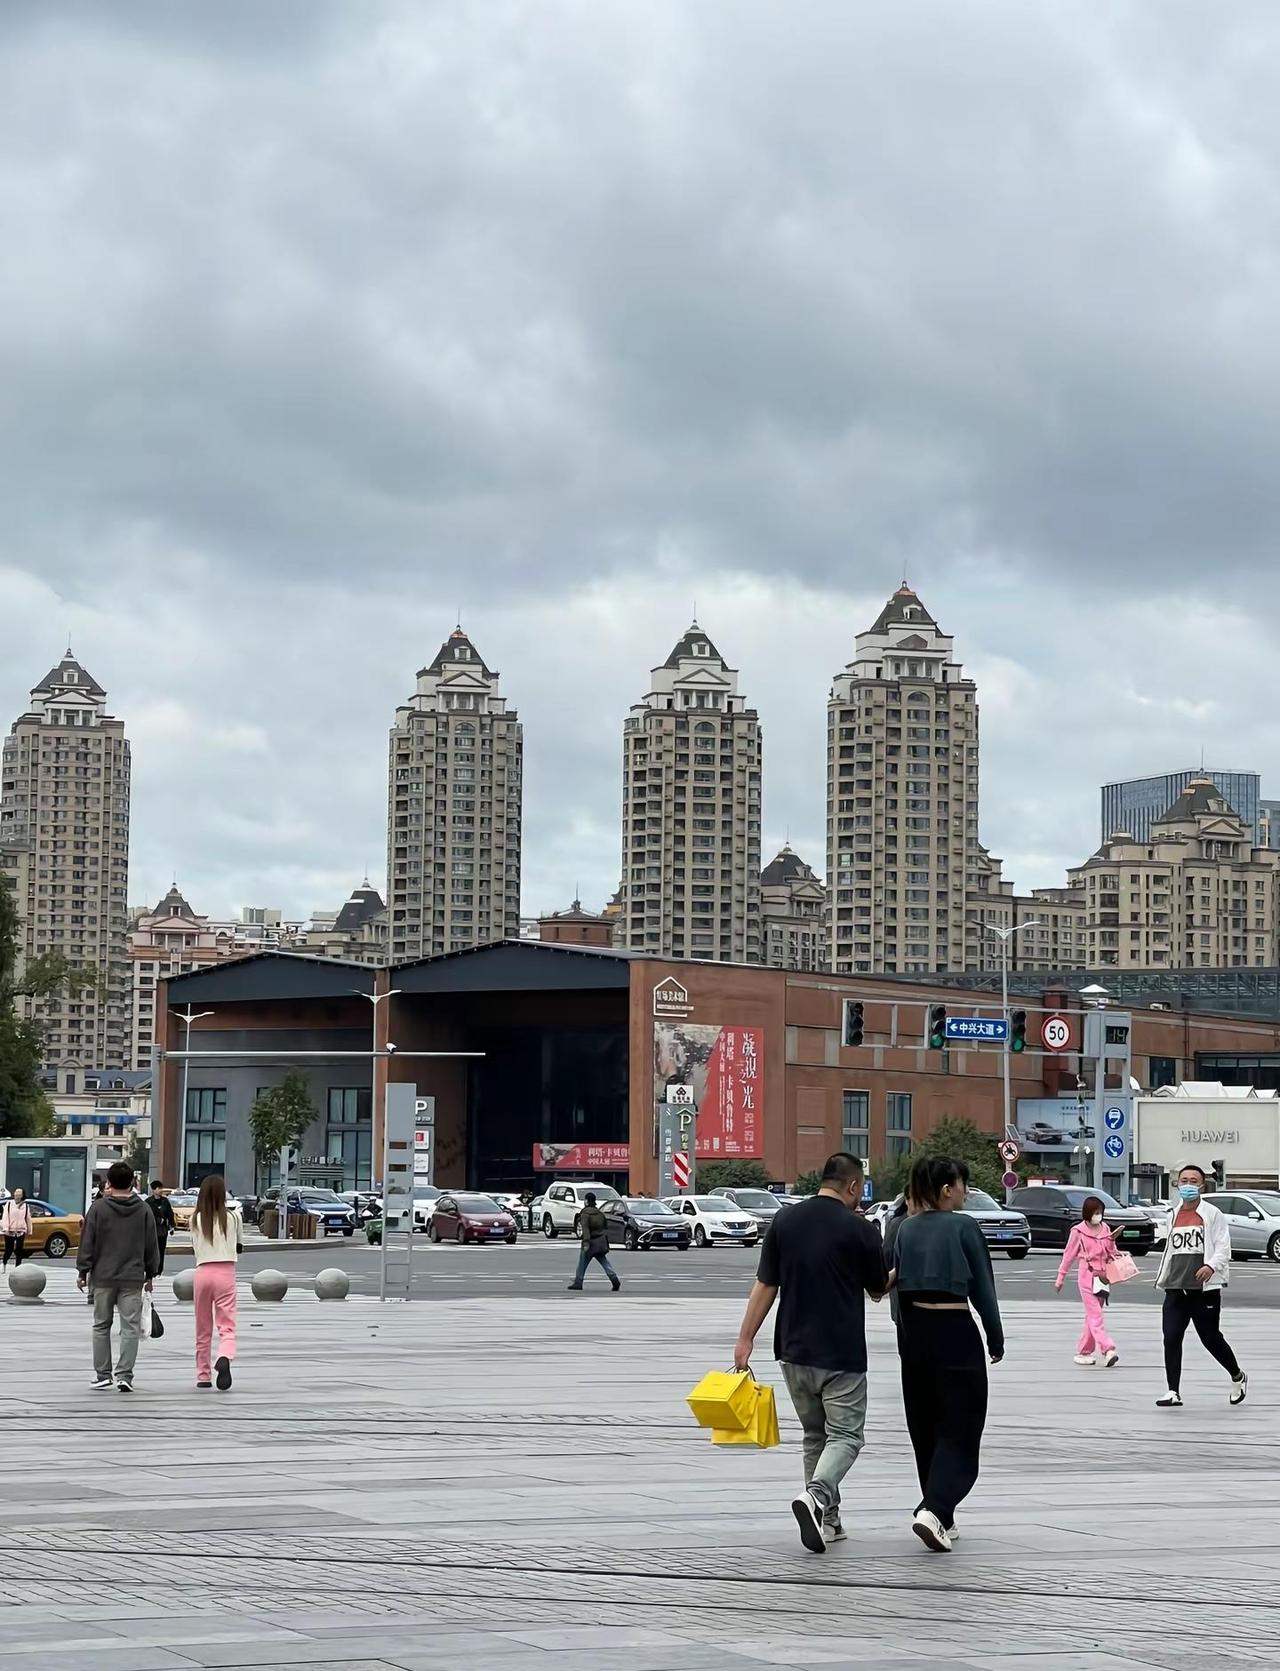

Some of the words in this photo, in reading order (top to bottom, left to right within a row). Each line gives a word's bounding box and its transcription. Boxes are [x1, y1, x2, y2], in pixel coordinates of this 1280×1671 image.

[959, 1022, 995, 1036] 中兴大道
[1048, 1026, 1065, 1041] 50
[415, 1100, 427, 1115] P
[680, 1114, 692, 1132] P
[1181, 1130, 1240, 1144] HUAWEI
